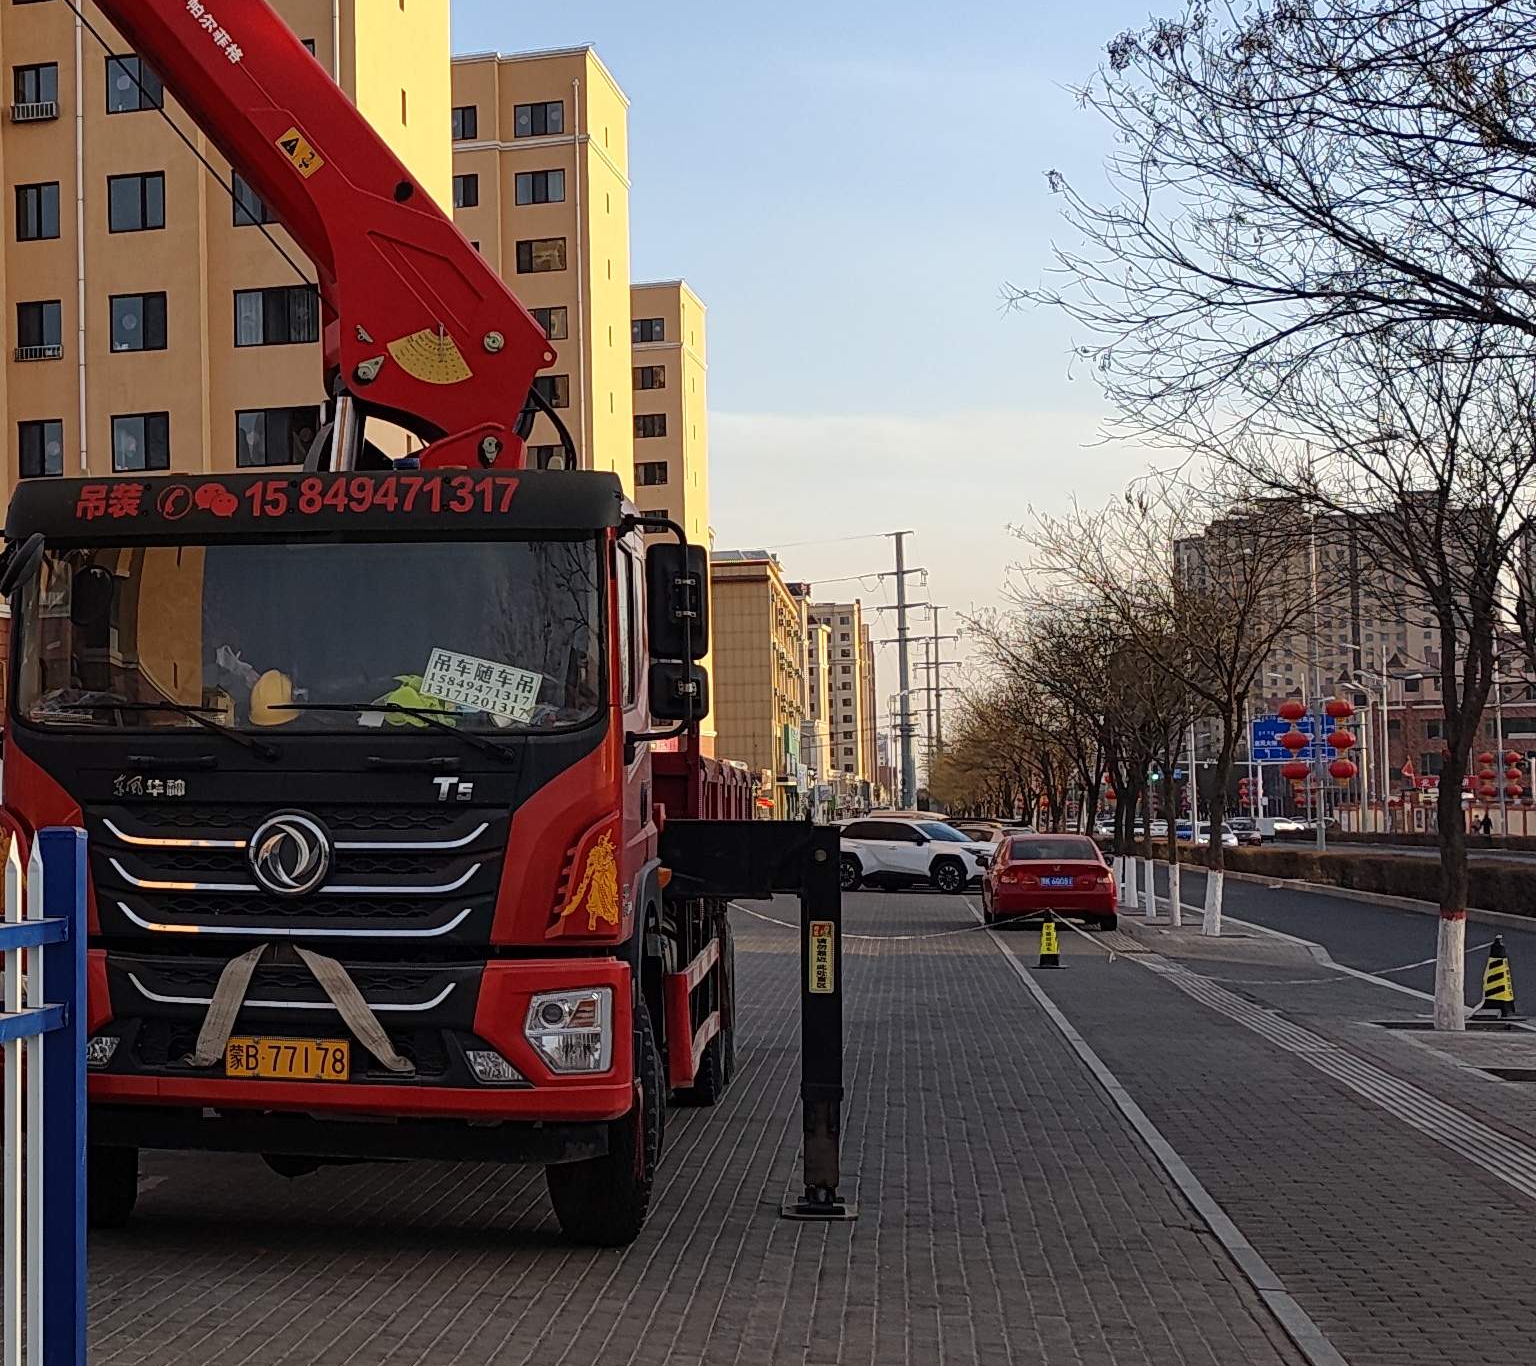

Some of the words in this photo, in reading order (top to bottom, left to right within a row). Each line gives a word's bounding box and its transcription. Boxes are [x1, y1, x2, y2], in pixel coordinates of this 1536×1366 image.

[76, 483, 143, 519] 吊装
[244, 476, 520, 517] 15849471317
[430, 672, 529, 706] 15849471317
[433, 653, 535, 694] 吊车随车吊
[426, 683, 528, 717] 13171201317
[432, 777, 474, 801] T5
